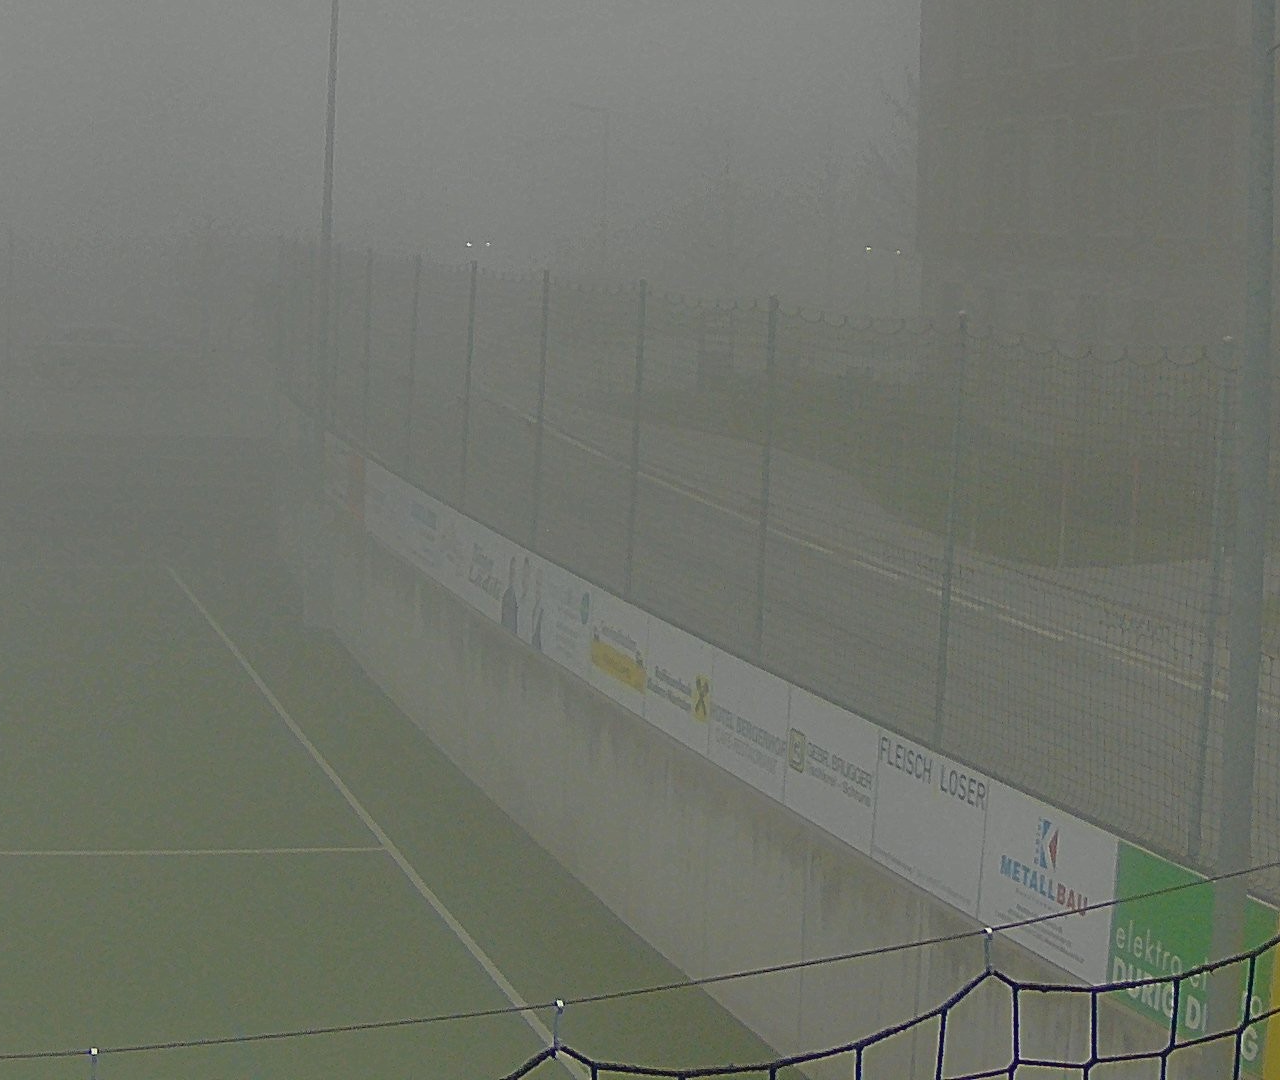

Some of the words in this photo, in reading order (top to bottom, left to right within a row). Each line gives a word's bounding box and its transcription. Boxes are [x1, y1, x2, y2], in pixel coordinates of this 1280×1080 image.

[880, 735, 933, 785] FLEISCH
[939, 763, 987, 811] LOSER
[1000, 854, 1088, 917] METALLBAU
[1115, 919, 1183, 978] elektro
